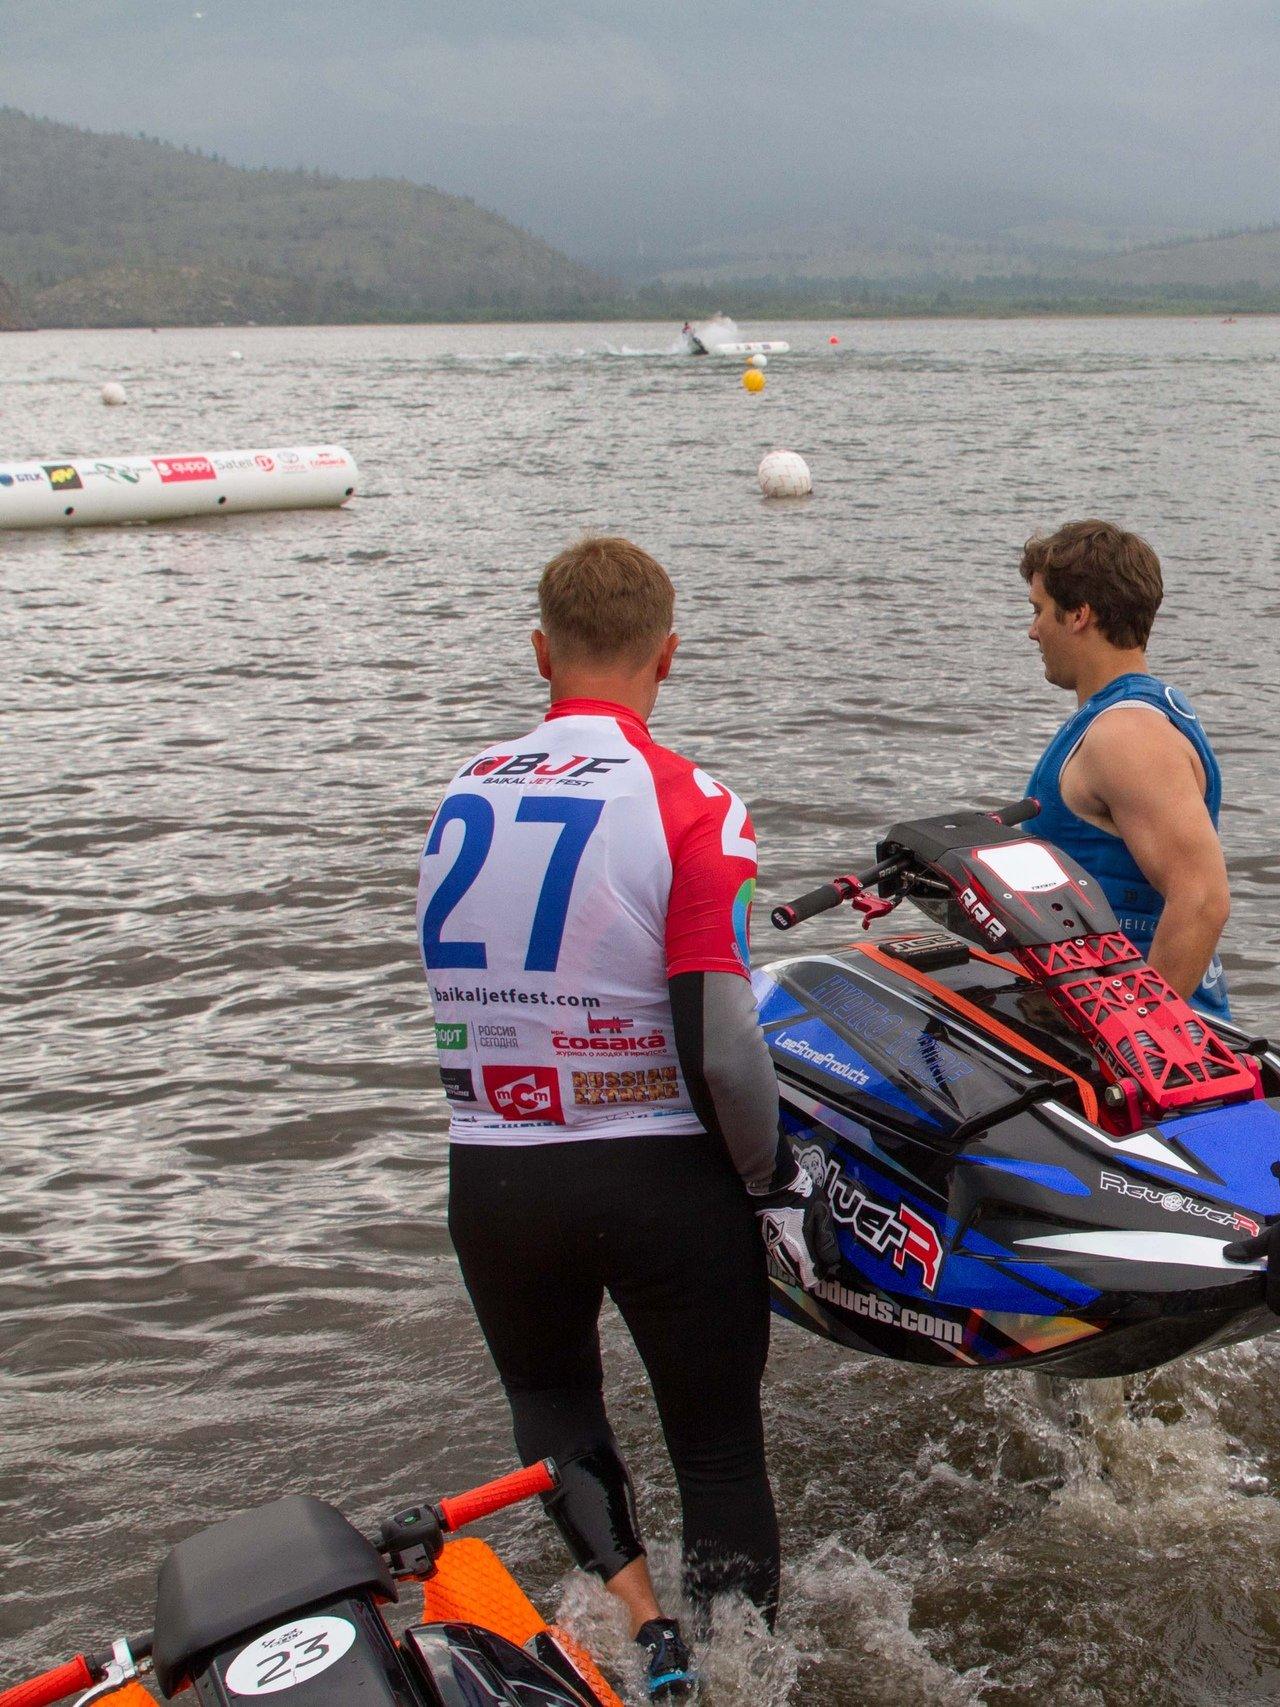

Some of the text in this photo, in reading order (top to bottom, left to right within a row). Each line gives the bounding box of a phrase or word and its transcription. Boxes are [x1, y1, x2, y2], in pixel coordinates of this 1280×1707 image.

[494, 752, 630, 778] BJF
[482, 776, 595, 788] BAIKAL JET FEST
[423, 793, 606, 972] 27
[434, 986, 601, 1008] baikaljetfest.com
[478, 1025, 517, 1037] РОССИЯ
[480, 1036, 519, 1049] СЕГОДНЯ
[256, 1631, 330, 1688] 23
